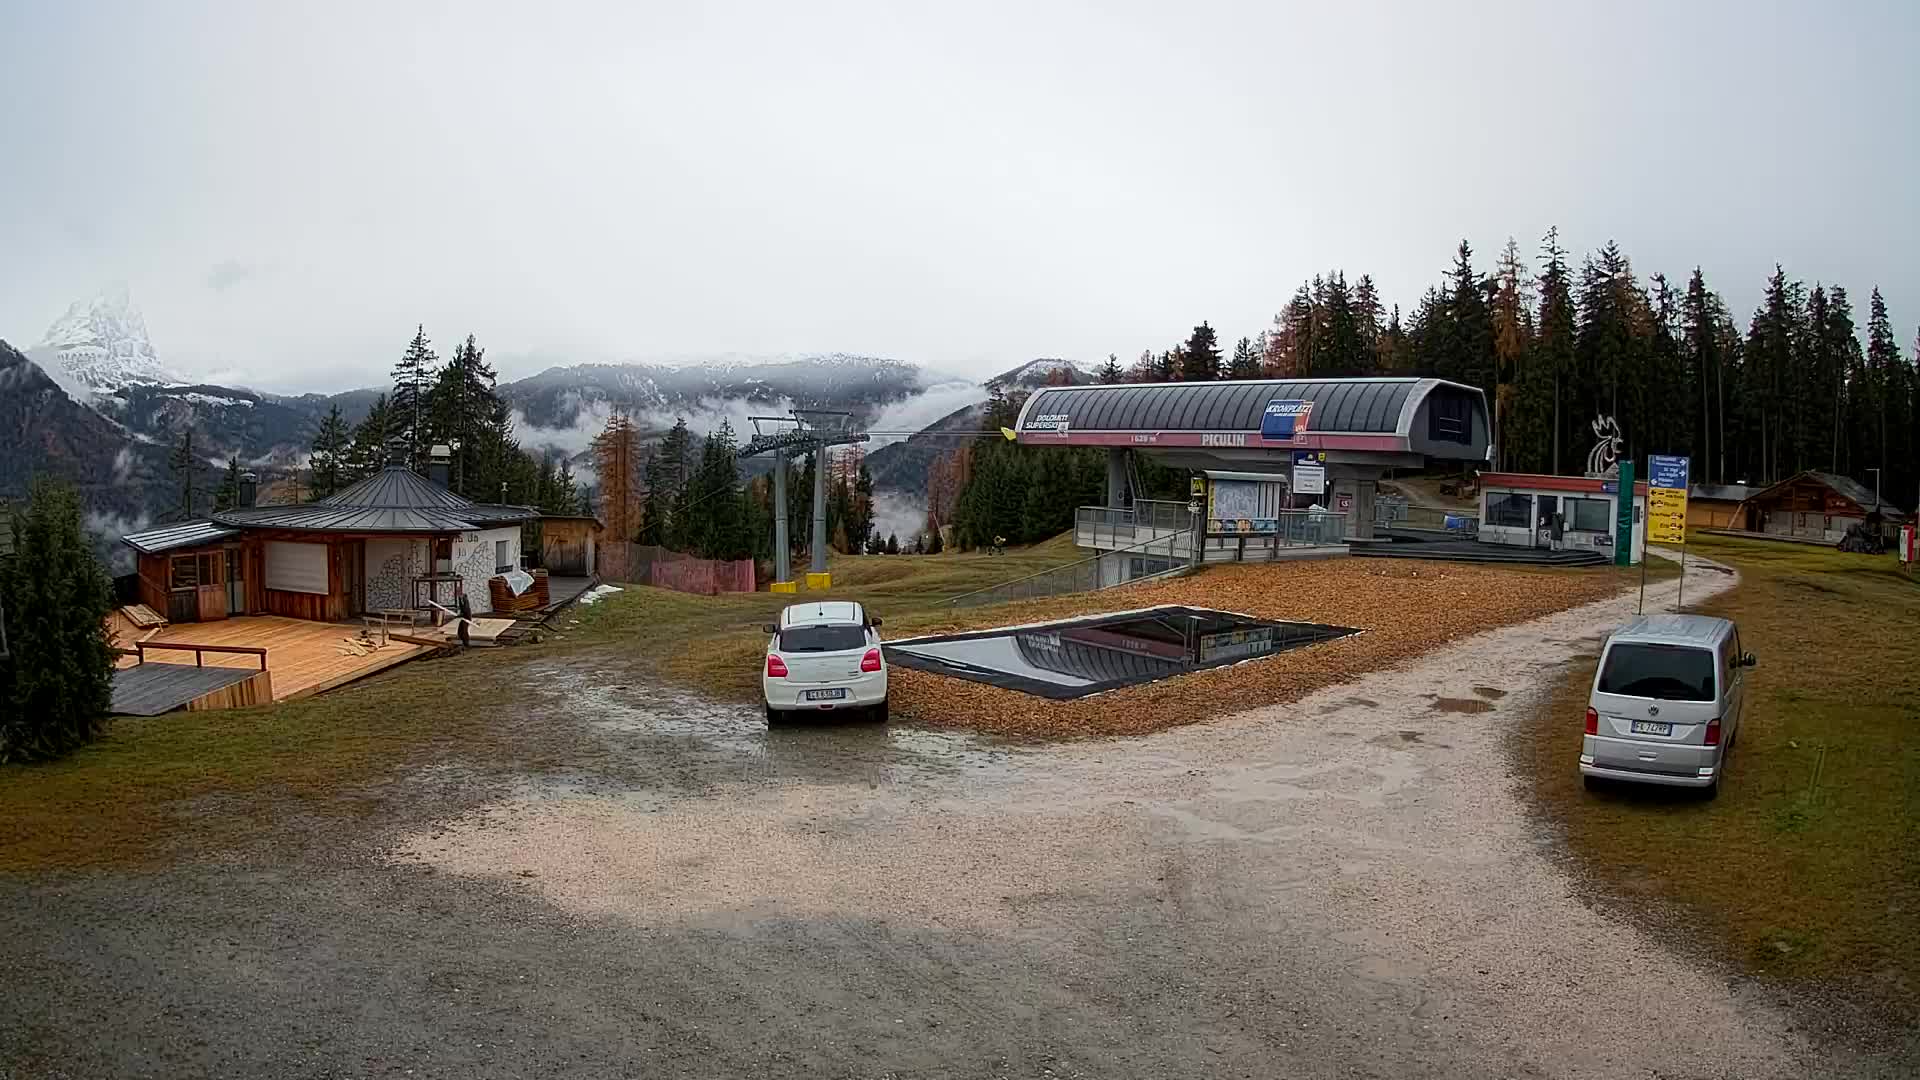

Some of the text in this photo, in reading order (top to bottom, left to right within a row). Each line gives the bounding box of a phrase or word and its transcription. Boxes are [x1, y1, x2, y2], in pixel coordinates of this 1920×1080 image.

[1266, 404, 1311, 413] KRONPLATZ
[1025, 421, 1058, 429] SUPERSKI
[1202, 434, 1245, 446] PICULIN
